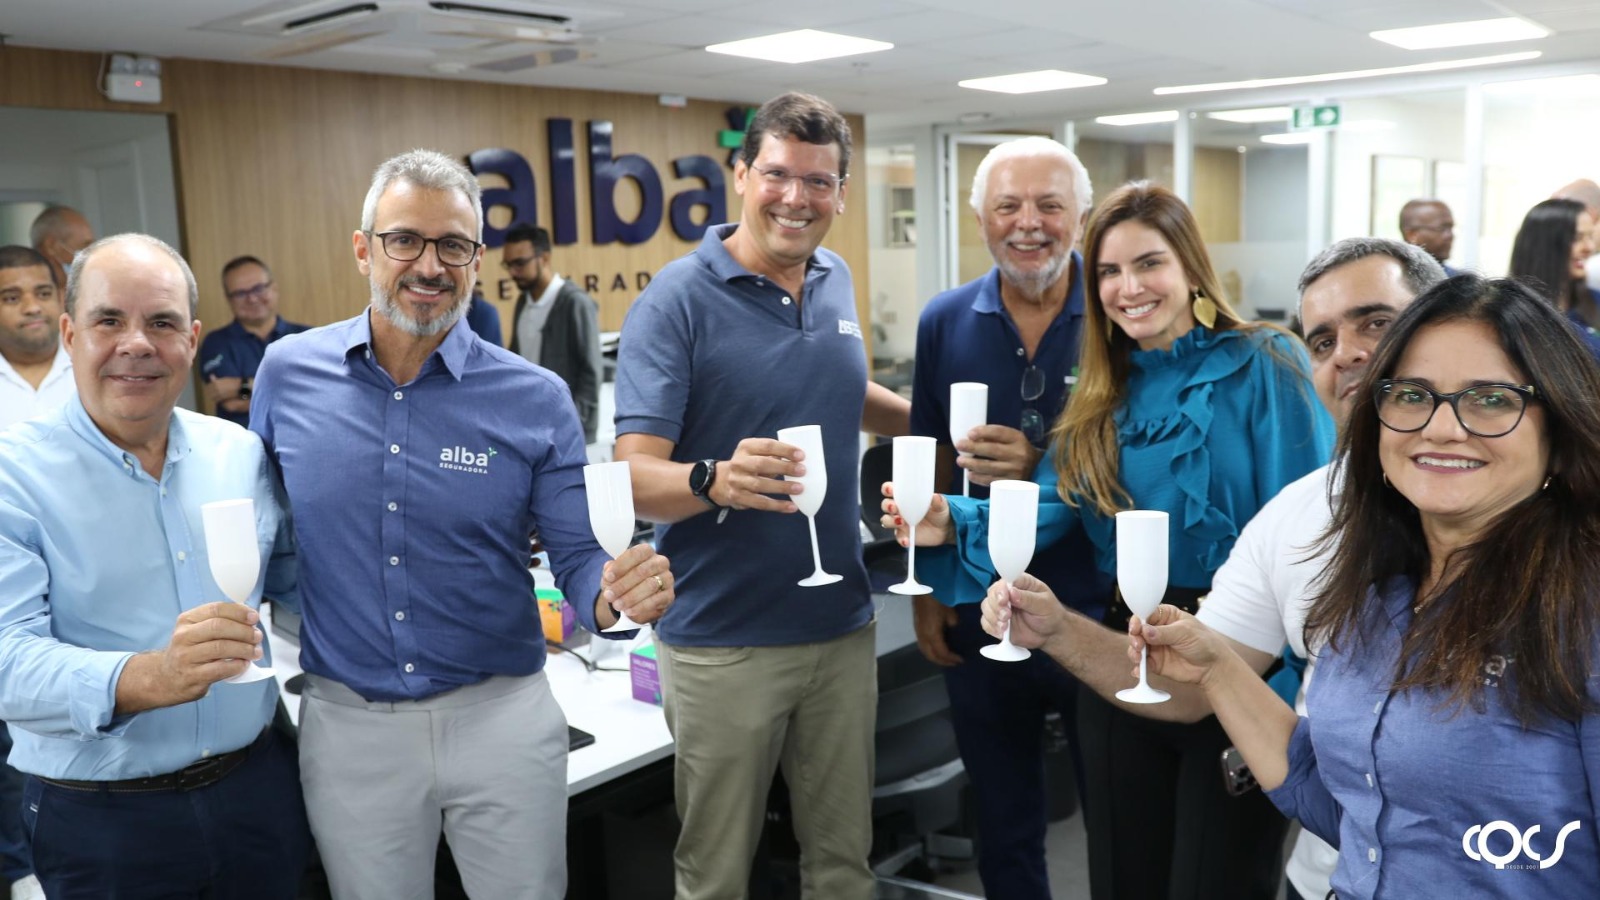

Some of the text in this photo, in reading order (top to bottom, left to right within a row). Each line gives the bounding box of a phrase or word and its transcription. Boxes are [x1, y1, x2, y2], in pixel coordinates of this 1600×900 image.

[467, 117, 728, 249] alba
[440, 445, 489, 467] alba
[439, 462, 488, 474] SEGURADORA
